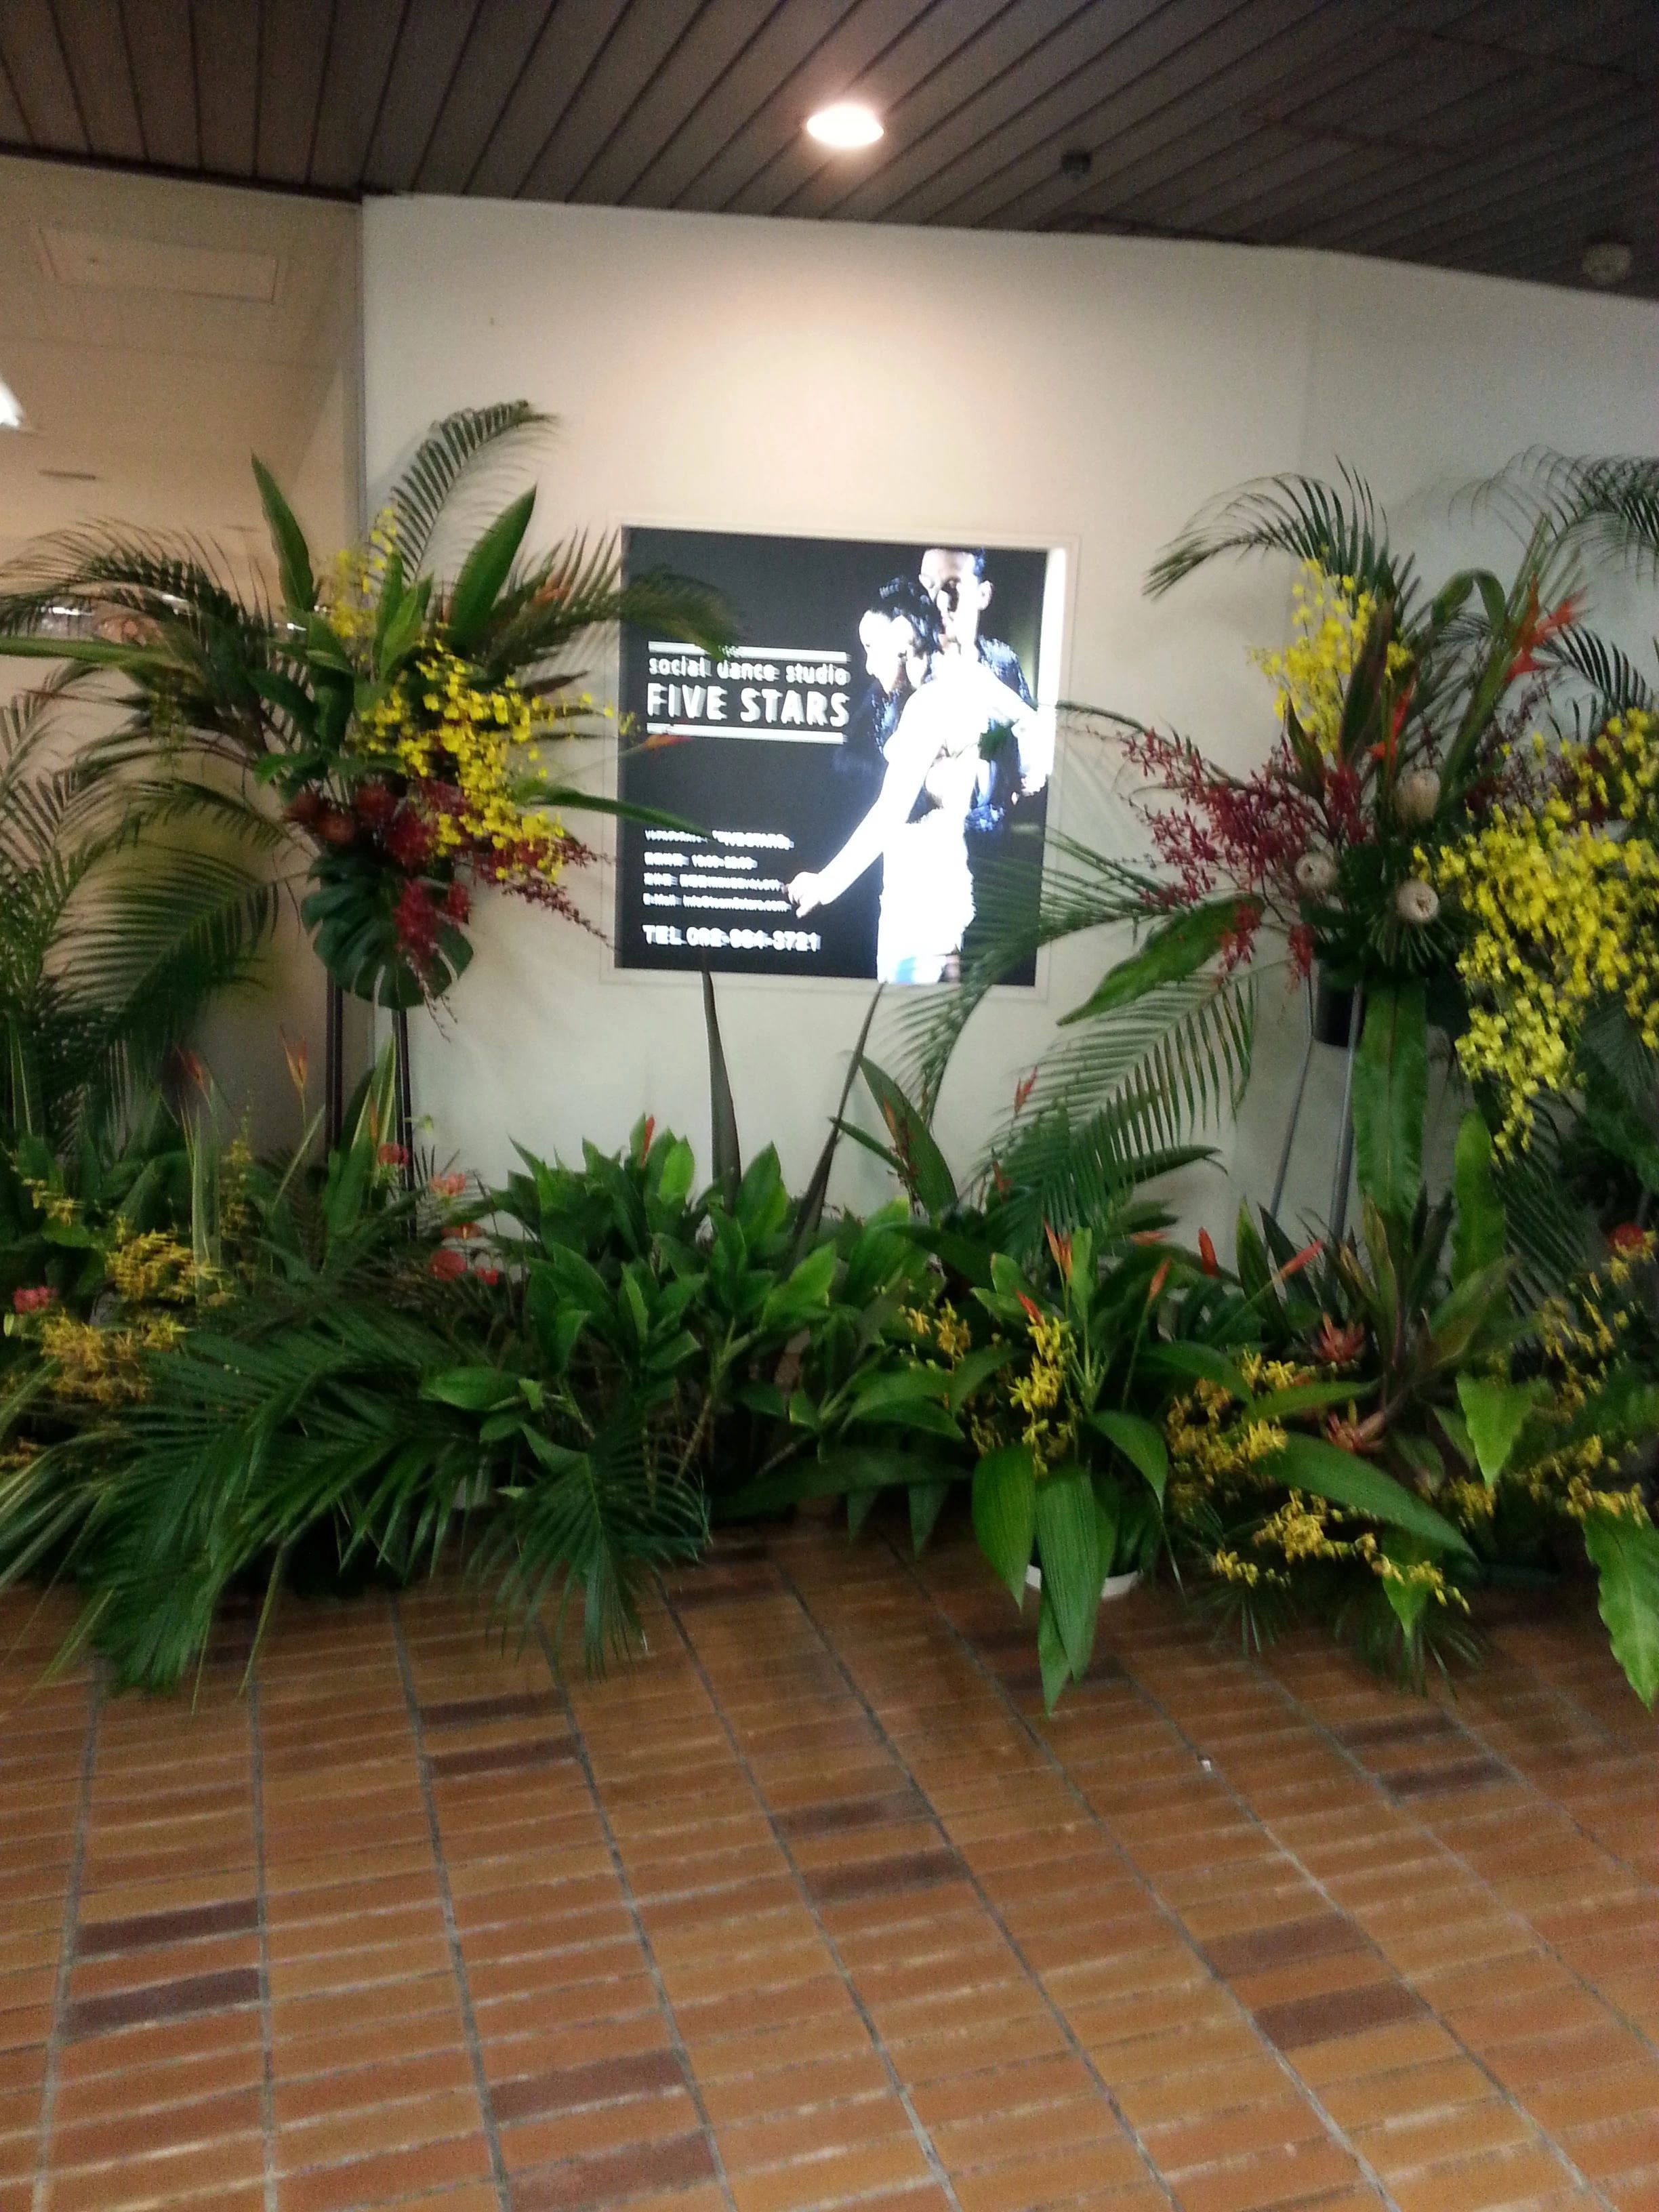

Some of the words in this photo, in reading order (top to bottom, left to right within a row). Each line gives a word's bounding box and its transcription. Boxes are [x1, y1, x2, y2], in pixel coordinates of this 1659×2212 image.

[649, 655, 711, 678] social
[716, 659, 779, 682] dance
[785, 663, 851, 686] studio
[647, 682, 728, 720] FIVE
[739, 687, 850, 727] STARS
